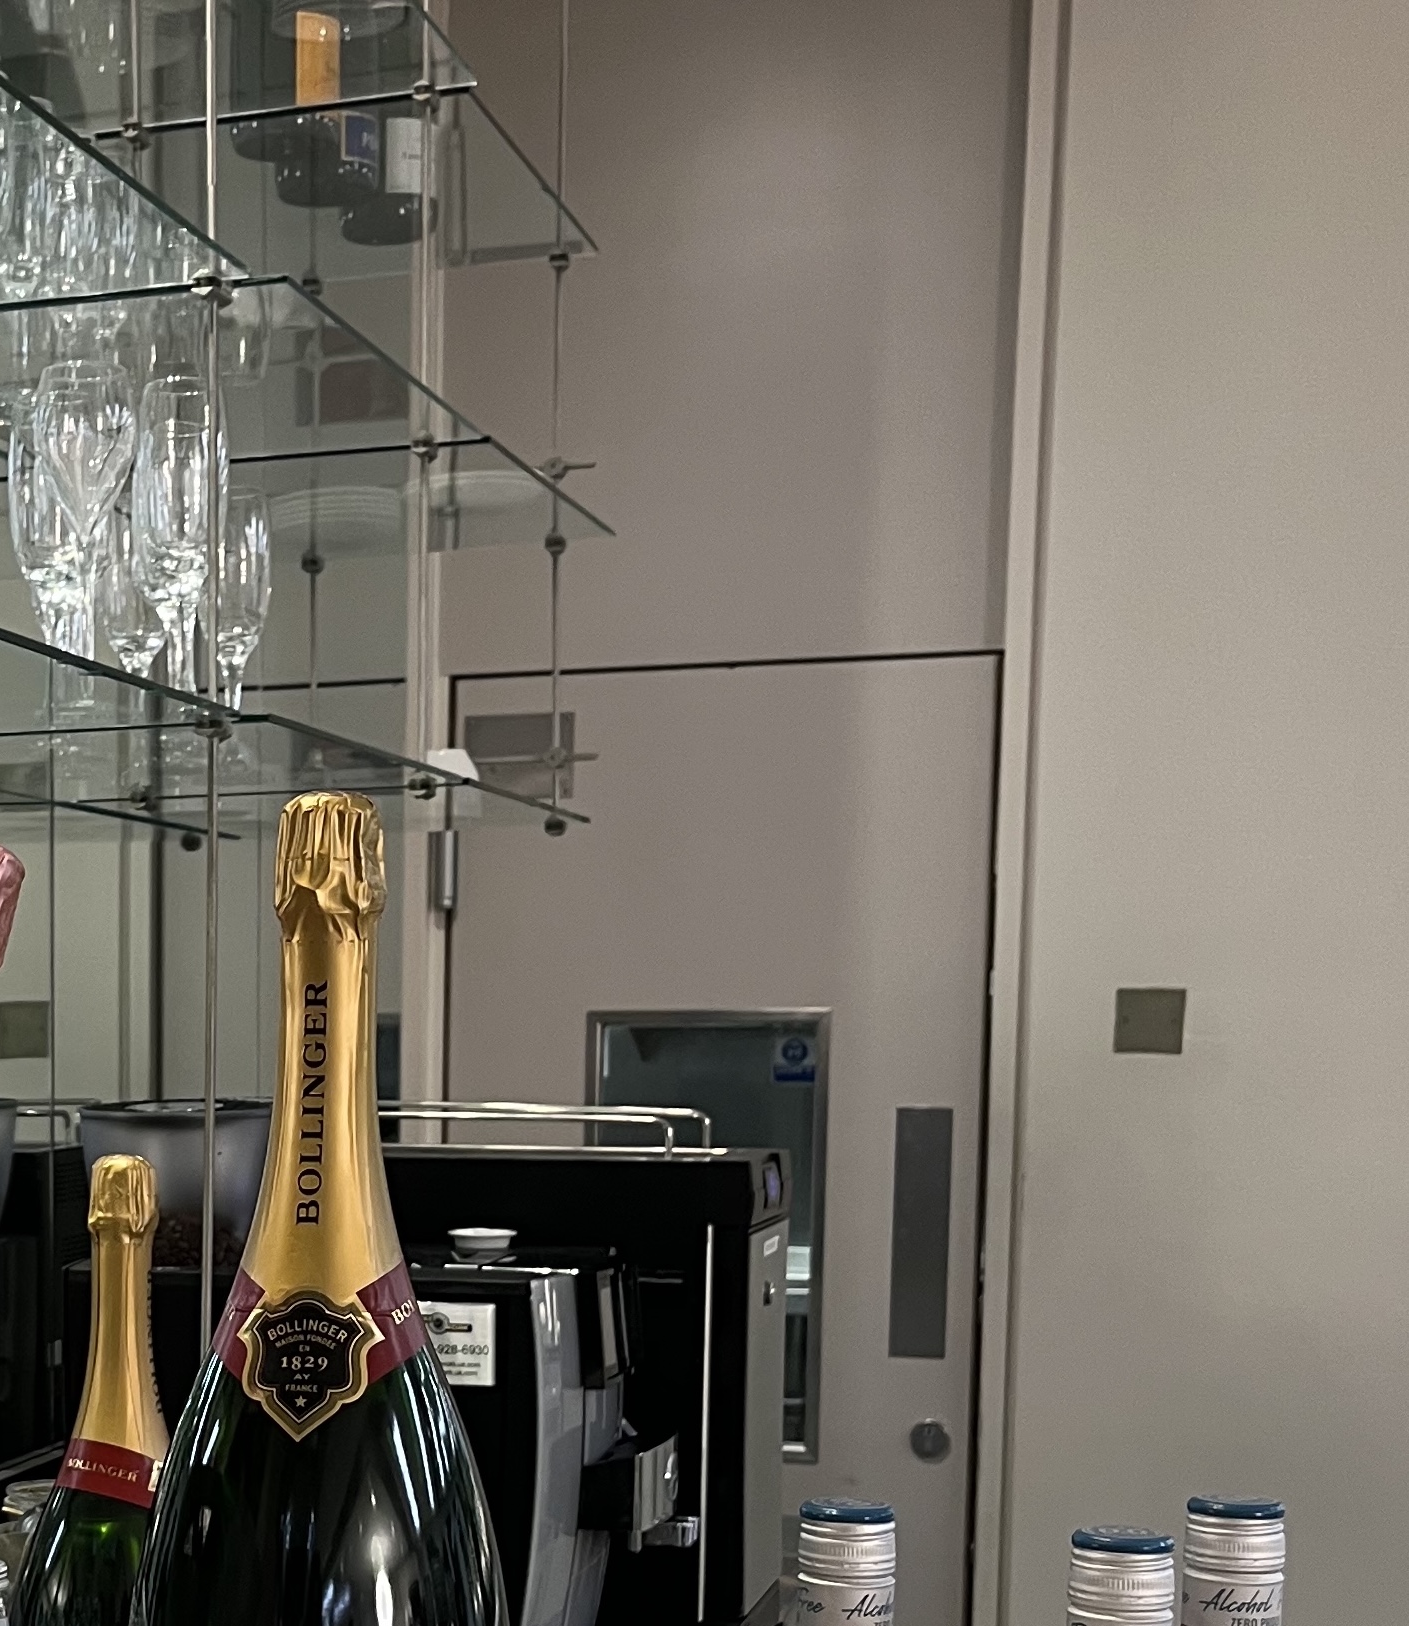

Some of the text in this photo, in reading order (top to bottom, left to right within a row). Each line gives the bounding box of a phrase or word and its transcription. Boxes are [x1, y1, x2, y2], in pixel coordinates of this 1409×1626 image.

[295, 980, 329, 1226] BOLLINGER
[267, 1318, 348, 1343] BOLLINGER
[281, 1356, 329, 1371] 1829
[285, 1384, 318, 1393] FRANCE
[1199, 1586, 1275, 1614] Alcohol
